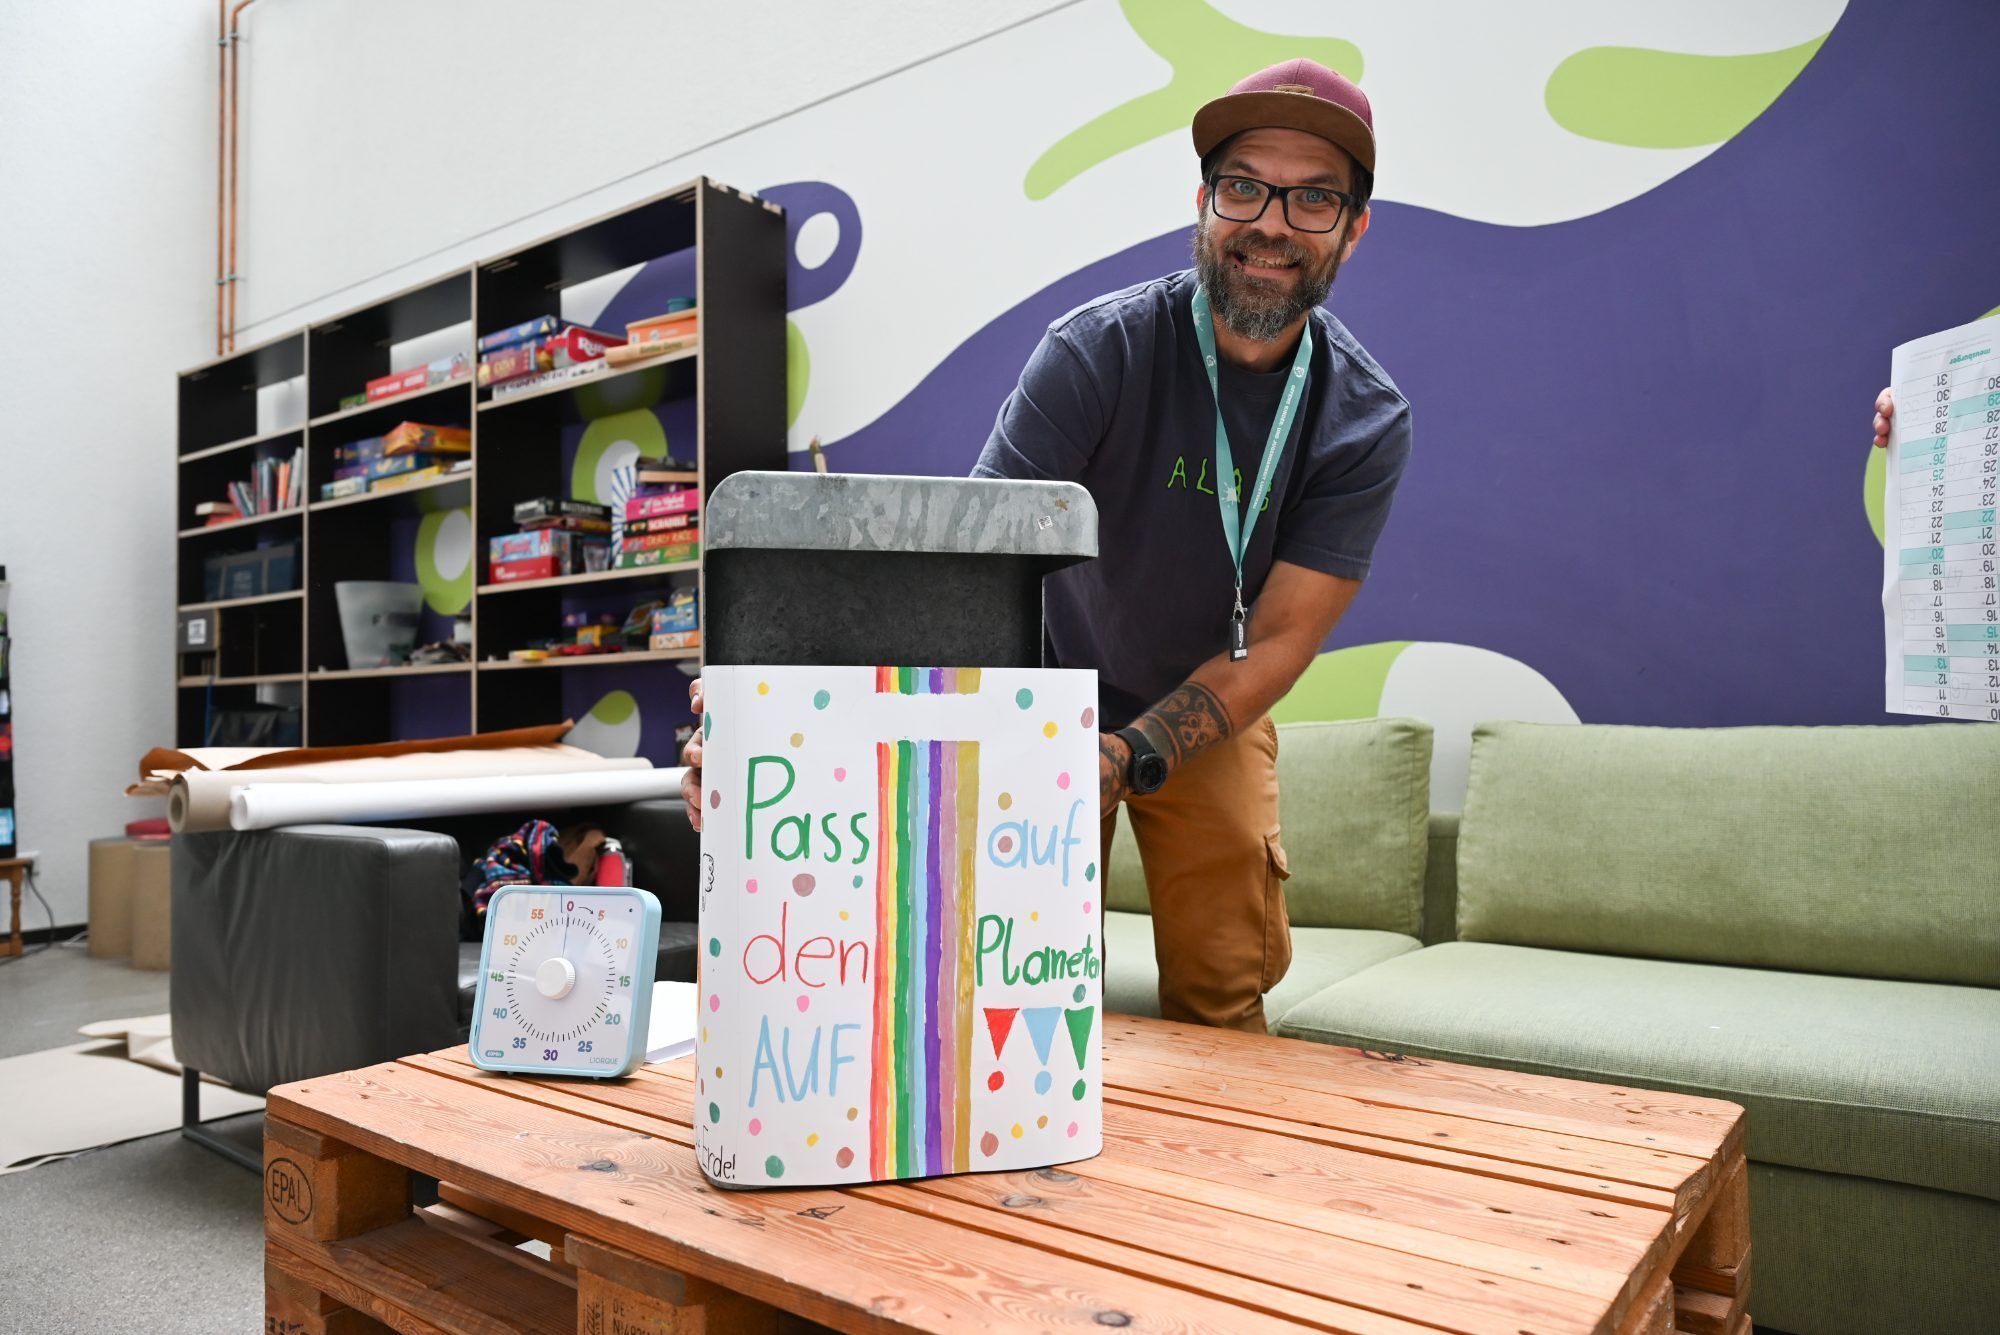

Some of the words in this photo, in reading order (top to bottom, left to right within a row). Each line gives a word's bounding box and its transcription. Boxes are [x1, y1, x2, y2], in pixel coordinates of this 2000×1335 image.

[1937, 374, 1948, 386] 31
[1937, 389, 1950, 402] 30
[1988, 393, 2000, 406] 29
[1936, 405, 1948, 418] 29
[1987, 410, 2000, 423] 28
[1936, 421, 1947, 433] 28
[1986, 426, 1998, 439] 27
[1934, 437, 1946, 449] 27
[1985, 443, 1998, 456] 26
[1933, 453, 1945, 465] 26
[1984, 460, 1997, 472] 25
[1933, 469, 1944, 481] 25
[1983, 476, 1996, 489] 24
[1932, 485, 1944, 496] 24
[1983, 493, 1995, 506] 23
[1932, 501, 1943, 512] 23
[1982, 510, 1994, 522] 22
[1932, 516, 1942, 528] 22
[1932, 533, 1941, 543] 21
[1983, 527, 1992, 539] 21
[1932, 548, 1944, 559] 20
[1983, 543, 1995, 555] 20
[1933, 564, 1942, 575] 19
[1983, 560, 1994, 572] 19
[1933, 580, 1943, 590] 18
[1984, 577, 1995, 588] 18
[1934, 596, 1943, 606] 17
[1986, 593, 1996, 605] 17
[1935, 611, 1944, 622] 16
[1987, 610, 1997, 621] 16
[1935, 627, 1944, 638] 15
[1987, 626, 1998, 638] 15
[1936, 643, 1946, 653] 14
[1987, 643, 1999, 654] 14
[1937, 658, 1947, 669] 13
[1988, 659, 1999, 671] 13
[1938, 674, 1947, 684] 12
[1989, 676, 2000, 687] 12
[1939, 689, 1946, 700] 11
[1990, 692, 1999, 703] 11
[1940, 705, 1949, 715] 10
[745, 756, 870, 864] Pass
[988, 799, 1085, 886] auf
[567, 901, 574, 911] 0
[531, 909, 544, 919] 55
[598, 910, 605, 920] 5
[504, 935, 517, 946] 50
[616, 939, 628, 949] 10
[743, 902, 869, 987] den
[491, 972, 504, 982] 45
[619, 976, 630, 987] 15
[493, 1008, 507, 1019] 40
[605, 1014, 620, 1025] 20
[512, 1037, 526, 1049] 35
[578, 1041, 592, 1052] 25
[543, 1050, 558, 1061] 30
[748, 1015, 861, 1107] AUF
[702, 1125, 735, 1179] Erde!
[273, 1168, 305, 1215] EPAL
